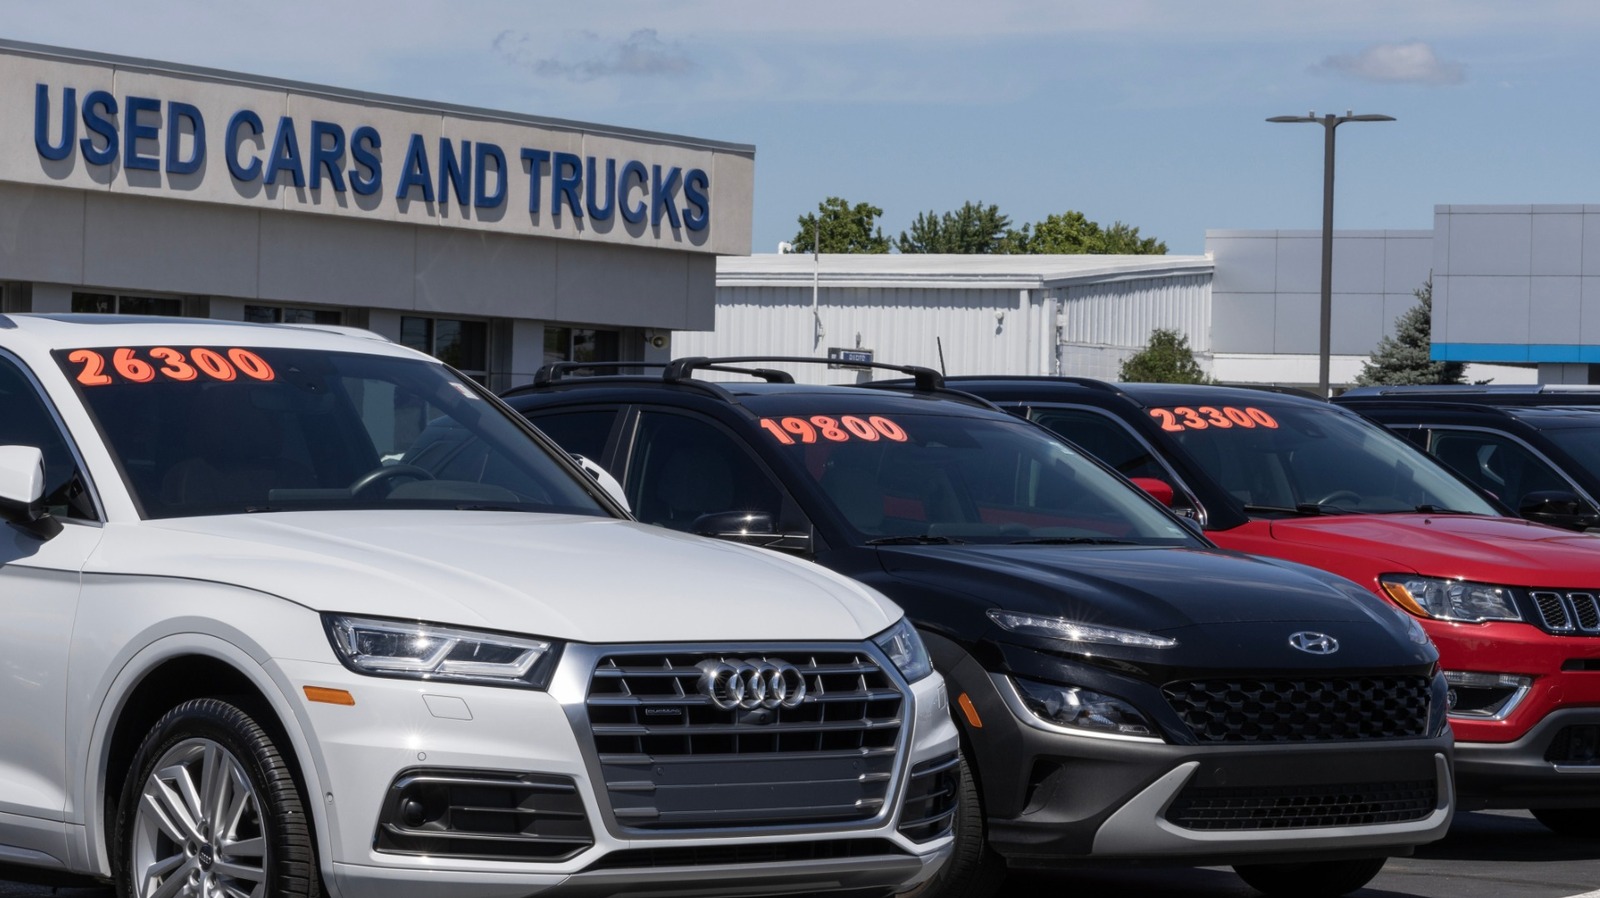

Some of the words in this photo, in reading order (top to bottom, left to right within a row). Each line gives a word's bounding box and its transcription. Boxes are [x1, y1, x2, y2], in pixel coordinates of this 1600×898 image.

[35, 83, 205, 173] USED
[225, 109, 381, 195] CARS
[396, 133, 507, 208] AND
[520, 148, 709, 230] TRUCKS
[68, 347, 275, 386] 26300
[760, 415, 908, 444] 19800
[1150, 406, 1278, 432] 23300
